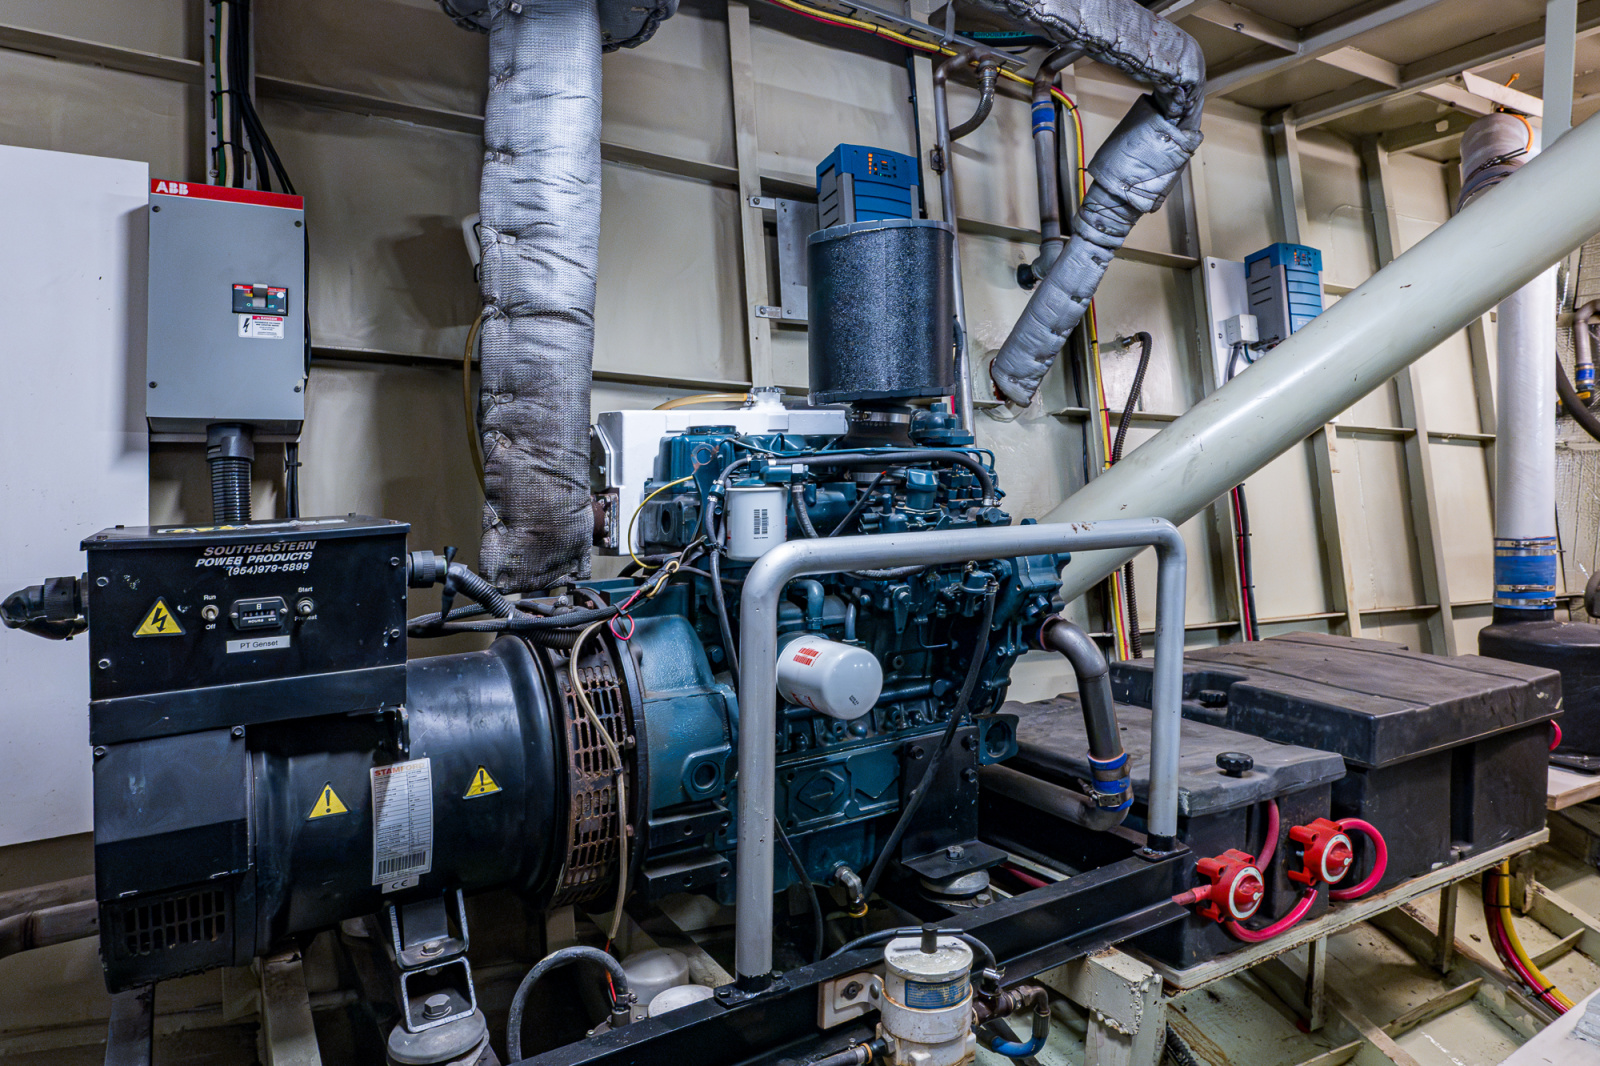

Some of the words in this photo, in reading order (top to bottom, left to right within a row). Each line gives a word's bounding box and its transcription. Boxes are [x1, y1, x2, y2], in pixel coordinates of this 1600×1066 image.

[155, 181, 189, 195] ABB
[204, 541, 317, 556] SOUTHEASTERN
[195, 556, 243, 568] POWER
[246, 551, 313, 564] PRODUCTS
[227, 562, 309, 576] (954)979-5899
[253, 640, 278, 648] Genset
[375, 763, 424, 777] STAMFORD
